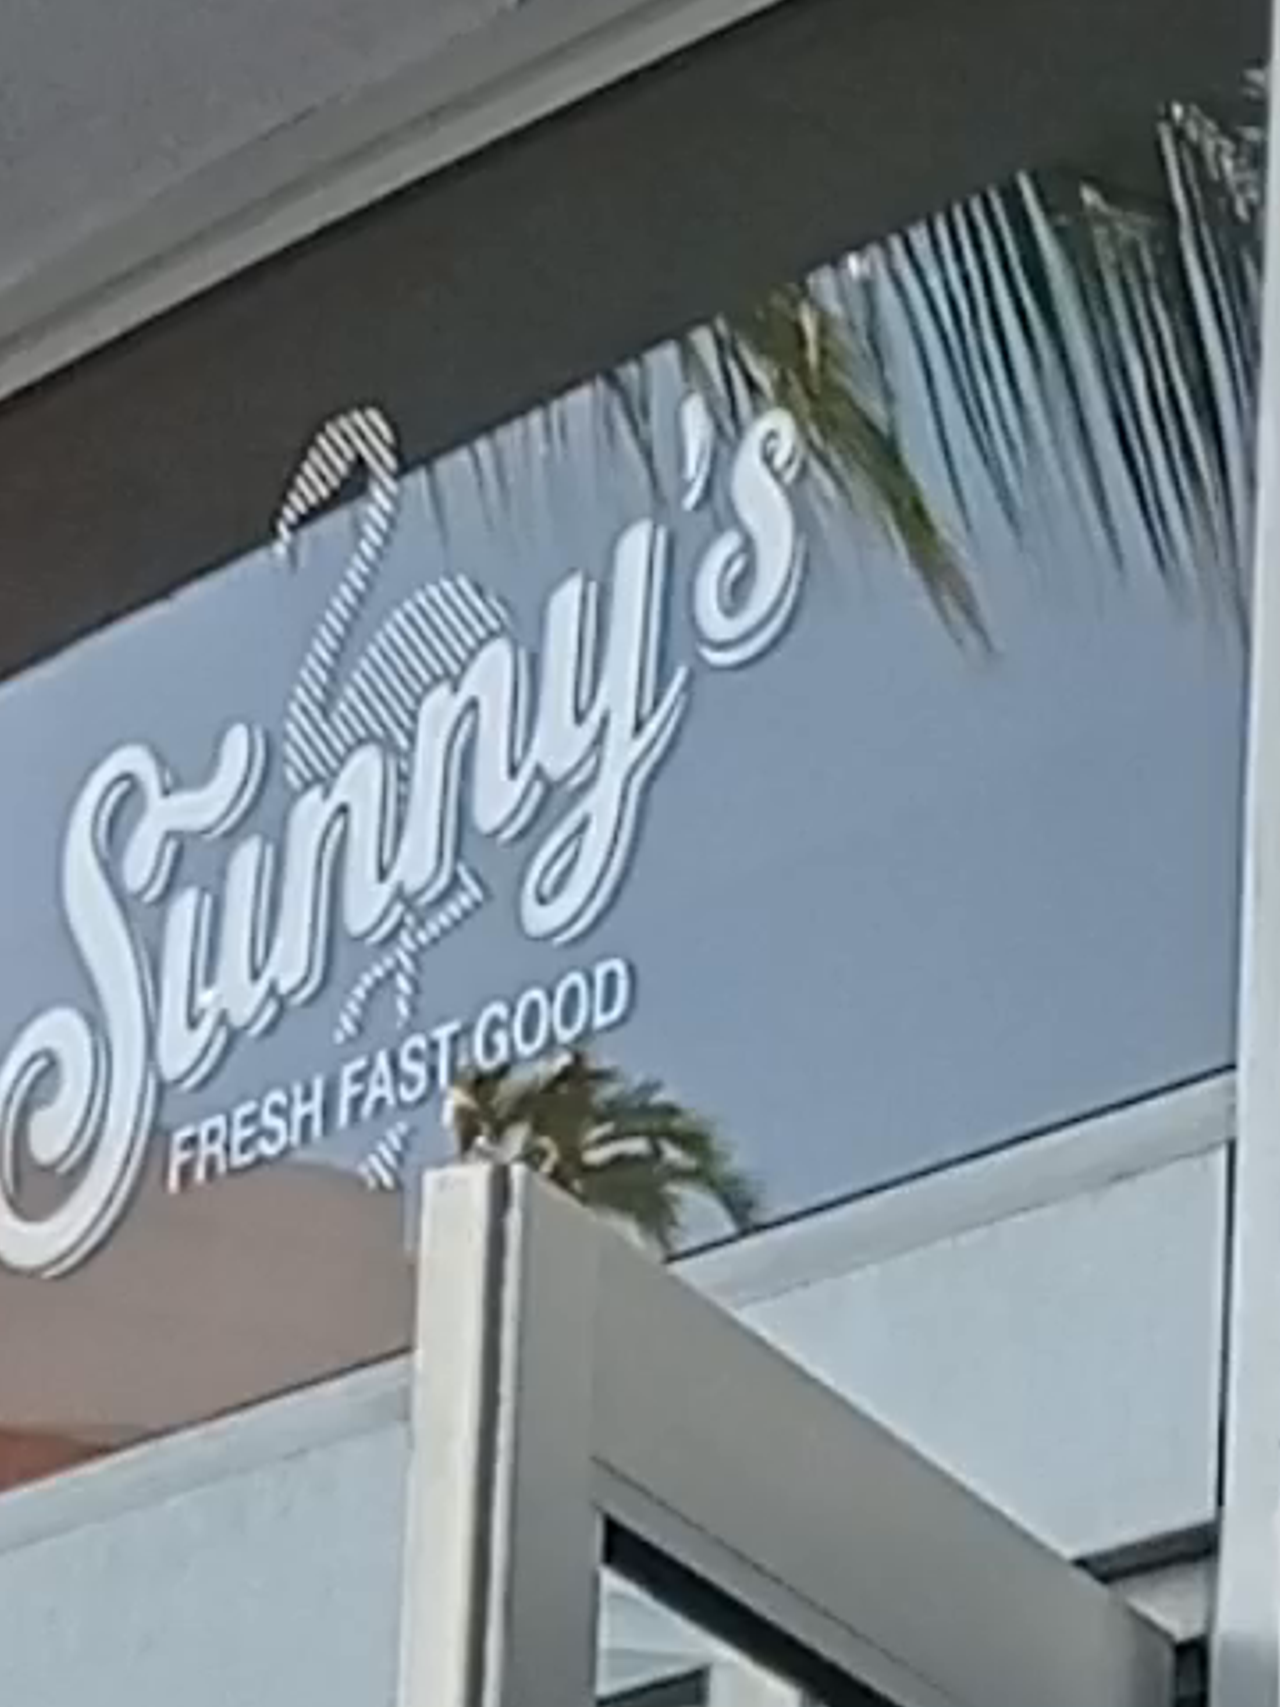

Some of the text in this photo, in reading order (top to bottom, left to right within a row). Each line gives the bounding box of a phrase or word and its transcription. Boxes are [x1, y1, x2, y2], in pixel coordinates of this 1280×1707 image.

[166, 956, 630, 1193] FRESH FAST GOOD
